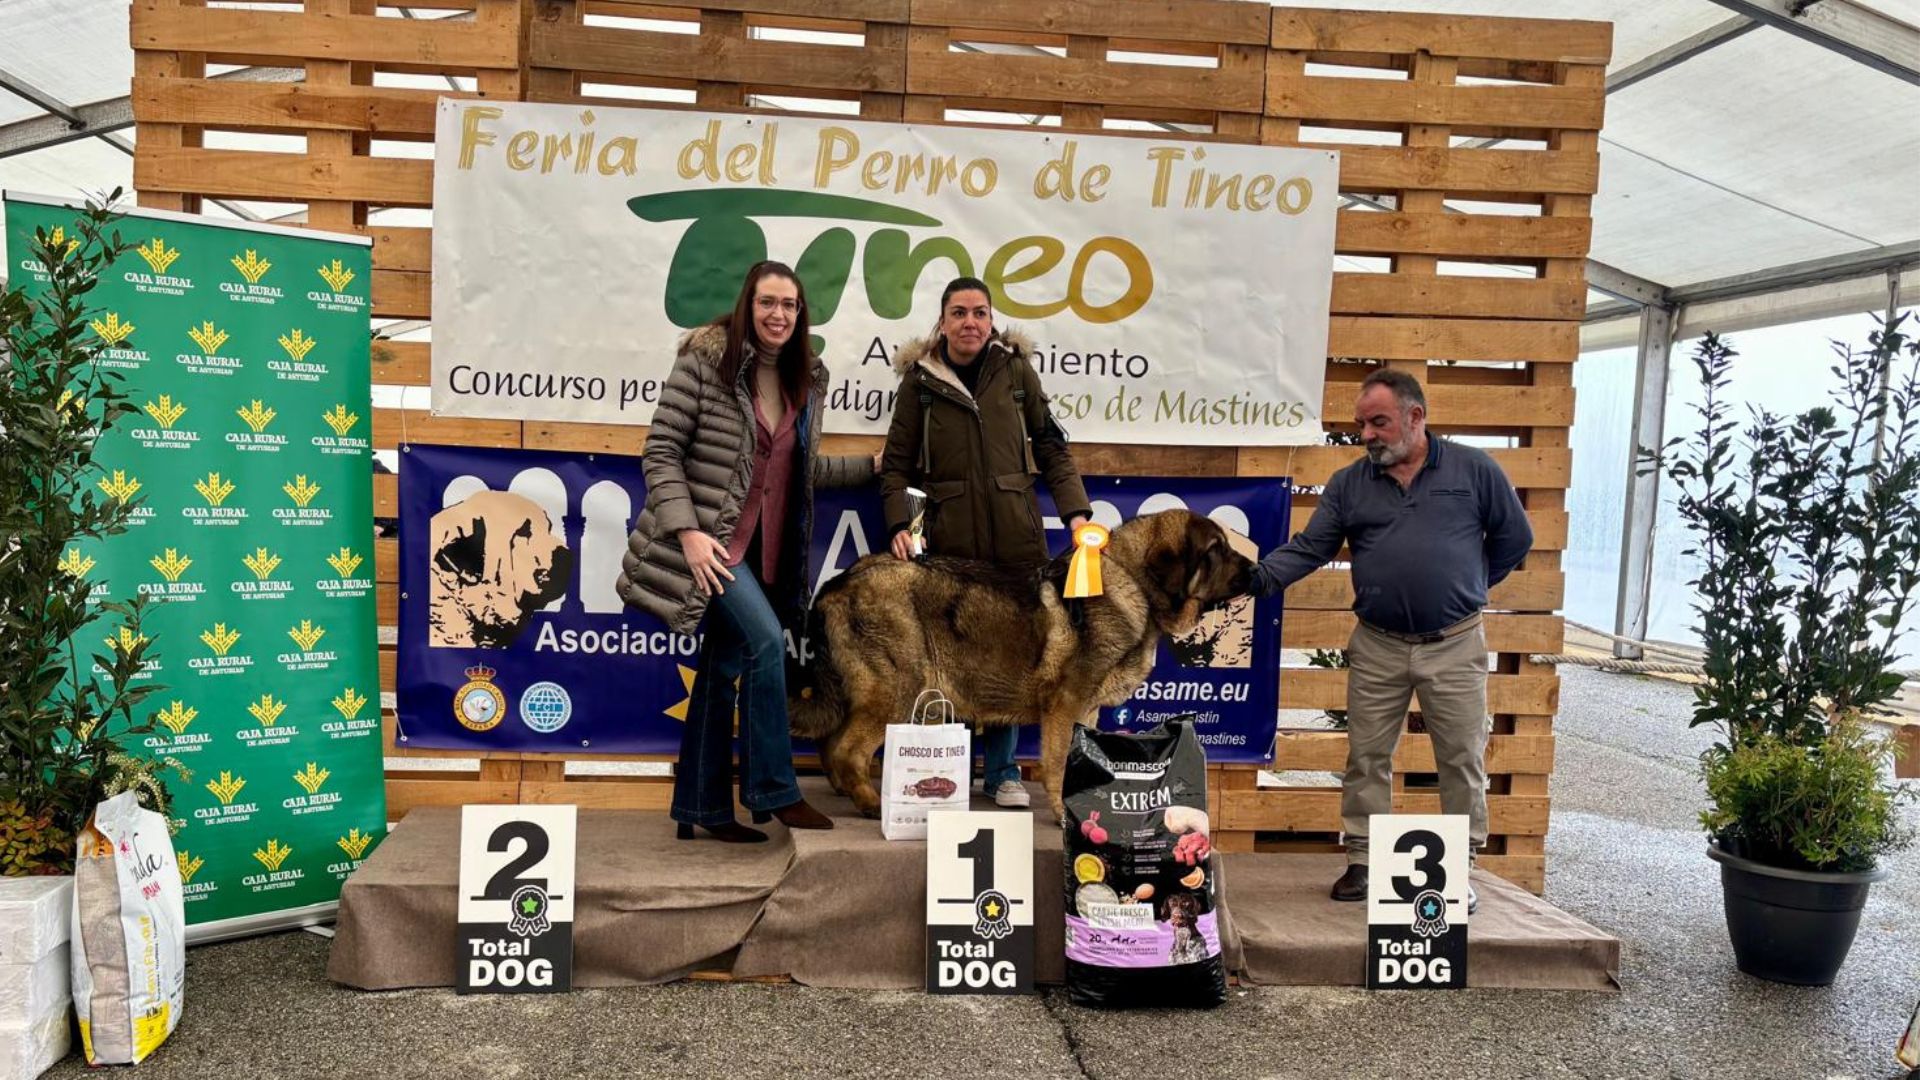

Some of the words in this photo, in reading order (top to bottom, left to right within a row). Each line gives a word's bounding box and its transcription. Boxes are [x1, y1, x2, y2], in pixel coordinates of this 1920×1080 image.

[458, 106, 638, 177] Feria
[677, 119, 777, 185] del
[815, 125, 998, 198] Perro
[1033, 140, 1111, 202] de
[1147, 145, 1313, 216] Tineo
[124, 272, 153, 284] CAJA
[155, 275, 194, 288] RURAL
[135, 283, 147, 292] DE
[146, 285, 184, 296] ASTURIAS
[219, 282, 246, 293] CAJA
[248, 284, 284, 297] RURAL
[229, 293, 240, 301] DE
[241, 294, 275, 304] ASTURIAS
[307, 291, 332, 302] CAJA
[333, 293, 365, 305] RURAL
[327, 303, 358, 313] ASTURIAS
[109, 349, 150, 361] RURAL
[175, 354, 204, 365] CAJA
[205, 355, 243, 368] RURAL
[186, 365, 198, 373] DE
[198, 366, 233, 375] ASTURIAS
[267, 360, 292, 371] CAJA
[293, 362, 328, 373] RURAL
[277, 371, 286, 379] DE
[287, 372, 319, 381] ASTURIAS
[449, 365, 606, 400] Concurso
[1104, 385, 1142, 422] de
[1154, 388, 1304, 428] Mastines
[131, 428, 160, 440] CAJA
[161, 429, 200, 441] RURAL
[225, 433, 252, 443] CAJA
[253, 433, 288, 444] RURAL
[142, 440, 154, 448] DE
[154, 440, 191, 449] ASTURIAS
[247, 444, 280, 452] ASTURIAS
[311, 436, 336, 446] CAJA
[337, 437, 368, 447] RURAL
[181, 507, 209, 518] CAJA
[211, 507, 248, 518] RURAL
[272, 508, 297, 518] CAJA
[298, 508, 332, 518] RURAL
[192, 517, 203, 525] DE
[204, 518, 239, 526] ASTURIAS
[292, 518, 324, 526] ASTURIAS
[137, 583, 166, 595] CAJA
[167, 582, 206, 594] RURAL
[230, 581, 257, 592] CAJA
[258, 580, 293, 591] RURAL
[316, 579, 341, 590] CAJA
[342, 579, 372, 589] RURAL
[188, 657, 215, 668] CAJA
[216, 655, 254, 666] RURAL
[277, 653, 302, 663] CAJA
[303, 651, 337, 662] RURAL
[210, 666, 245, 675] ASTURIAS
[297, 662, 328, 670] ASTURIAS
[236, 728, 262, 739] CAJA
[264, 725, 299, 737] RURAL
[321, 721, 345, 732] CAJA
[346, 719, 377, 730] RURAL
[174, 733, 212, 745] RURAL
[340, 729, 370, 738] ASTURIAS
[246, 739, 257, 747] DE
[257, 736, 290, 746] ASTURIAS
[154, 747, 166, 755] DE
[166, 744, 202, 754] ASTURIAS
[899, 745, 932, 758] CHOSCO
[933, 747, 944, 758] DE
[946, 745, 967, 757] TINEO
[282, 796, 307, 808] CAJA
[309, 792, 342, 805] RURAL
[1110, 786, 1171, 811] EXTREM
[194, 807, 221, 818] CAJA
[222, 802, 259, 815] RURAL
[292, 807, 302, 815] DE
[302, 804, 333, 814] ASTURIAS
[215, 814, 250, 824] ASTURIAS
[484, 820, 549, 898] 2
[957, 828, 995, 899] 1
[1391, 829, 1447, 900] 3
[327, 862, 351, 873] CAJA
[242, 873, 268, 886] CAJA
[269, 868, 305, 882] RURAL
[252, 884, 262, 892] DE
[262, 880, 296, 891] ASTURIAS
[468, 938, 531, 957] Total
[937, 940, 995, 958] Total
[1377, 938, 1431, 955] Total
[469, 958, 553, 987] DOG
[938, 960, 1017, 988] DOG
[1378, 957, 1452, 983] DOG
